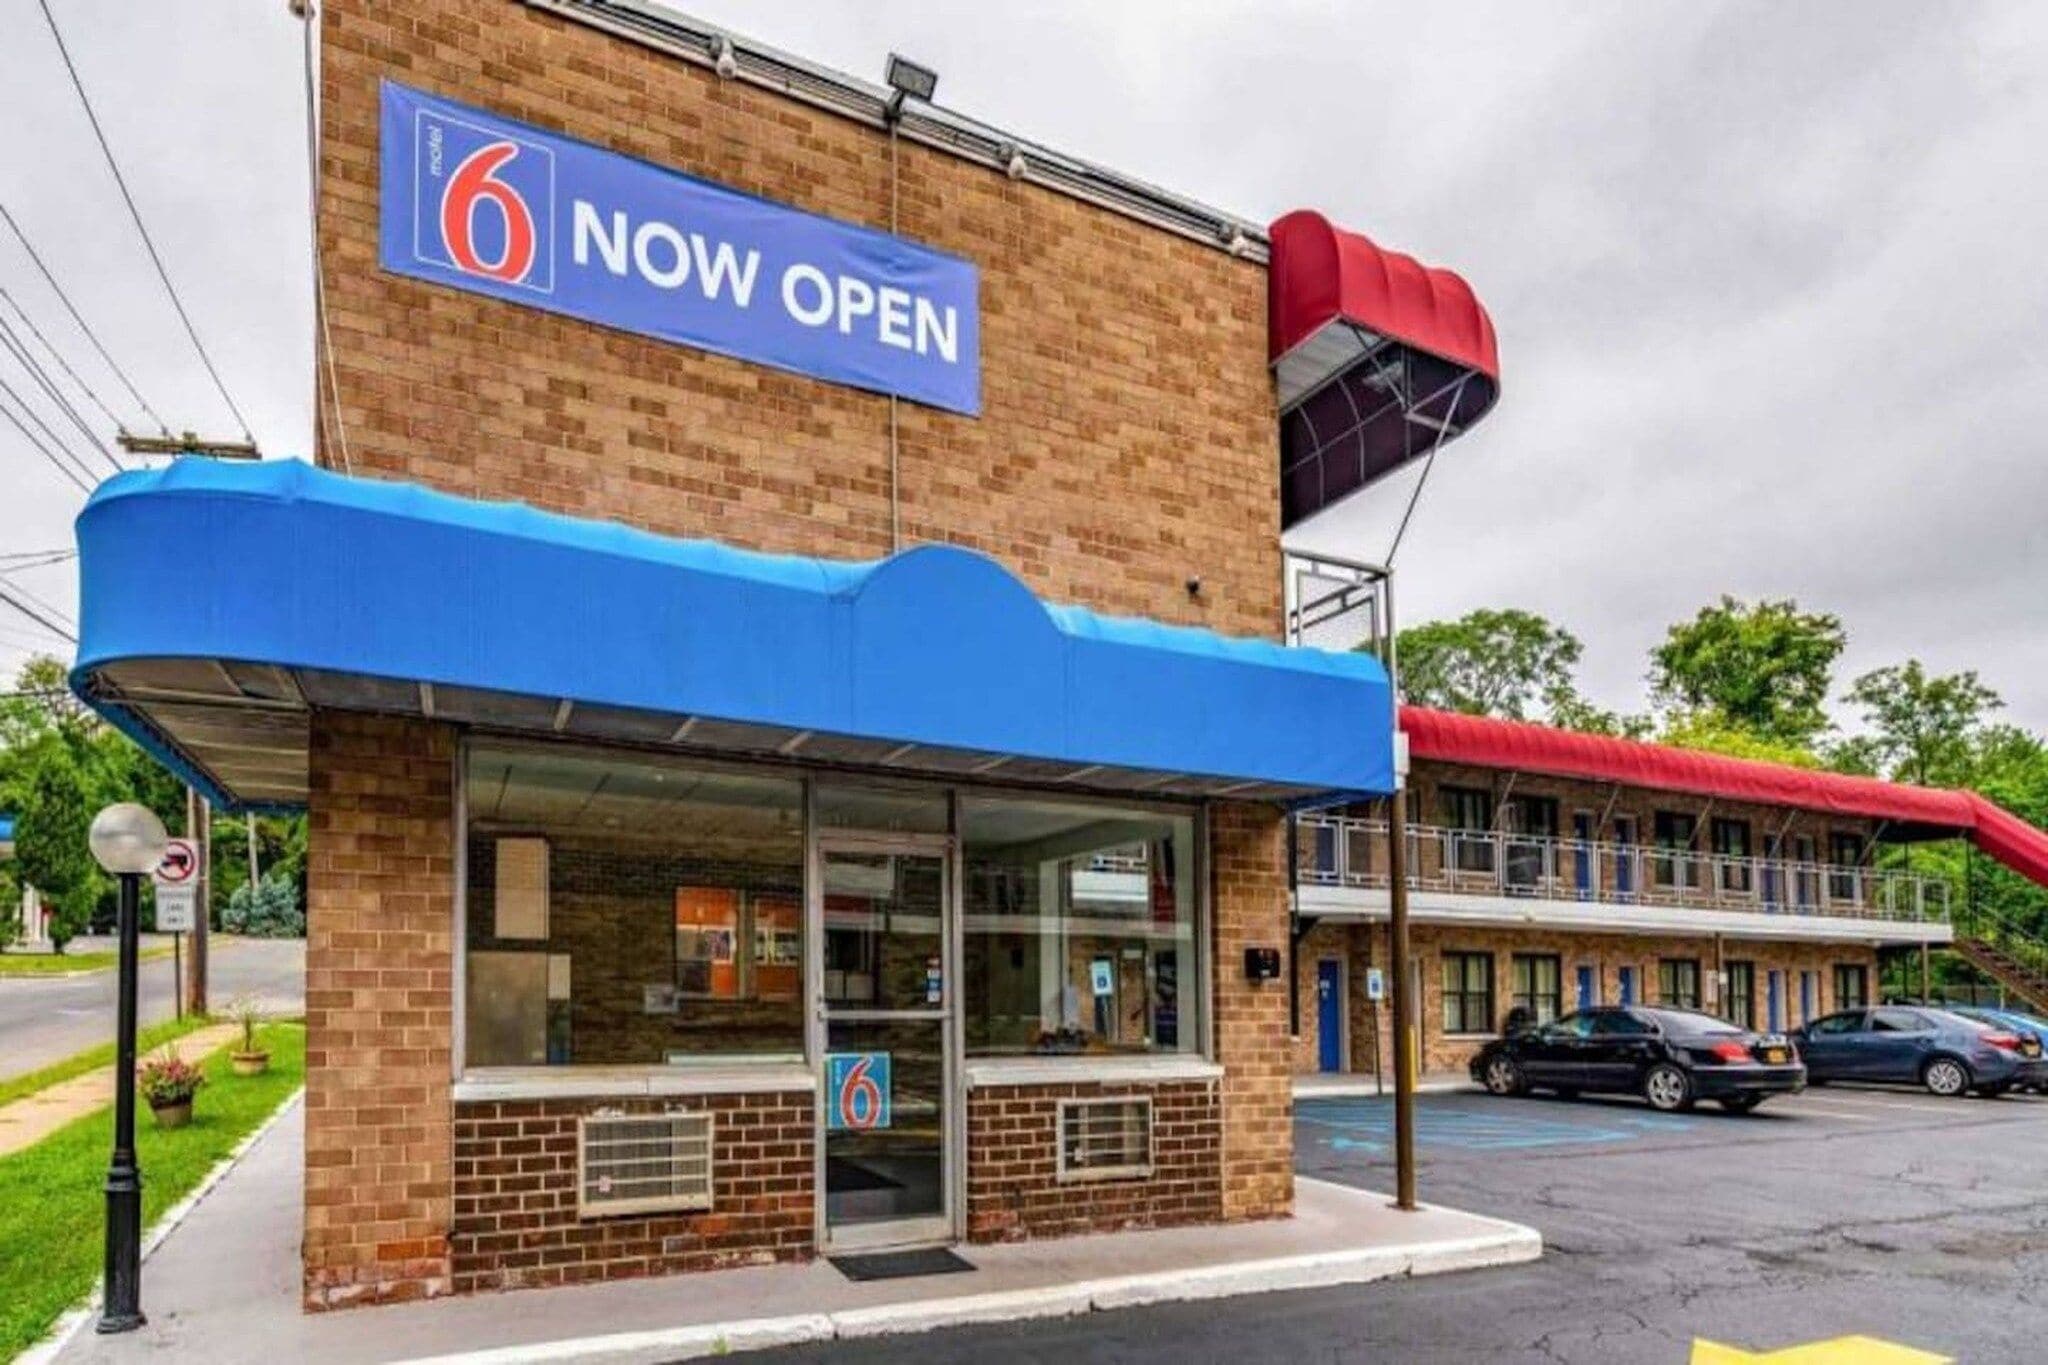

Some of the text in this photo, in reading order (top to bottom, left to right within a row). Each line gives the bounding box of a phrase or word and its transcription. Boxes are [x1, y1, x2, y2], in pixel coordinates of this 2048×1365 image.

[428, 125, 444, 177] motel
[440, 141, 536, 284] 6
[573, 200, 958, 363] NOW OPEN
[840, 1056, 881, 1132] 6
